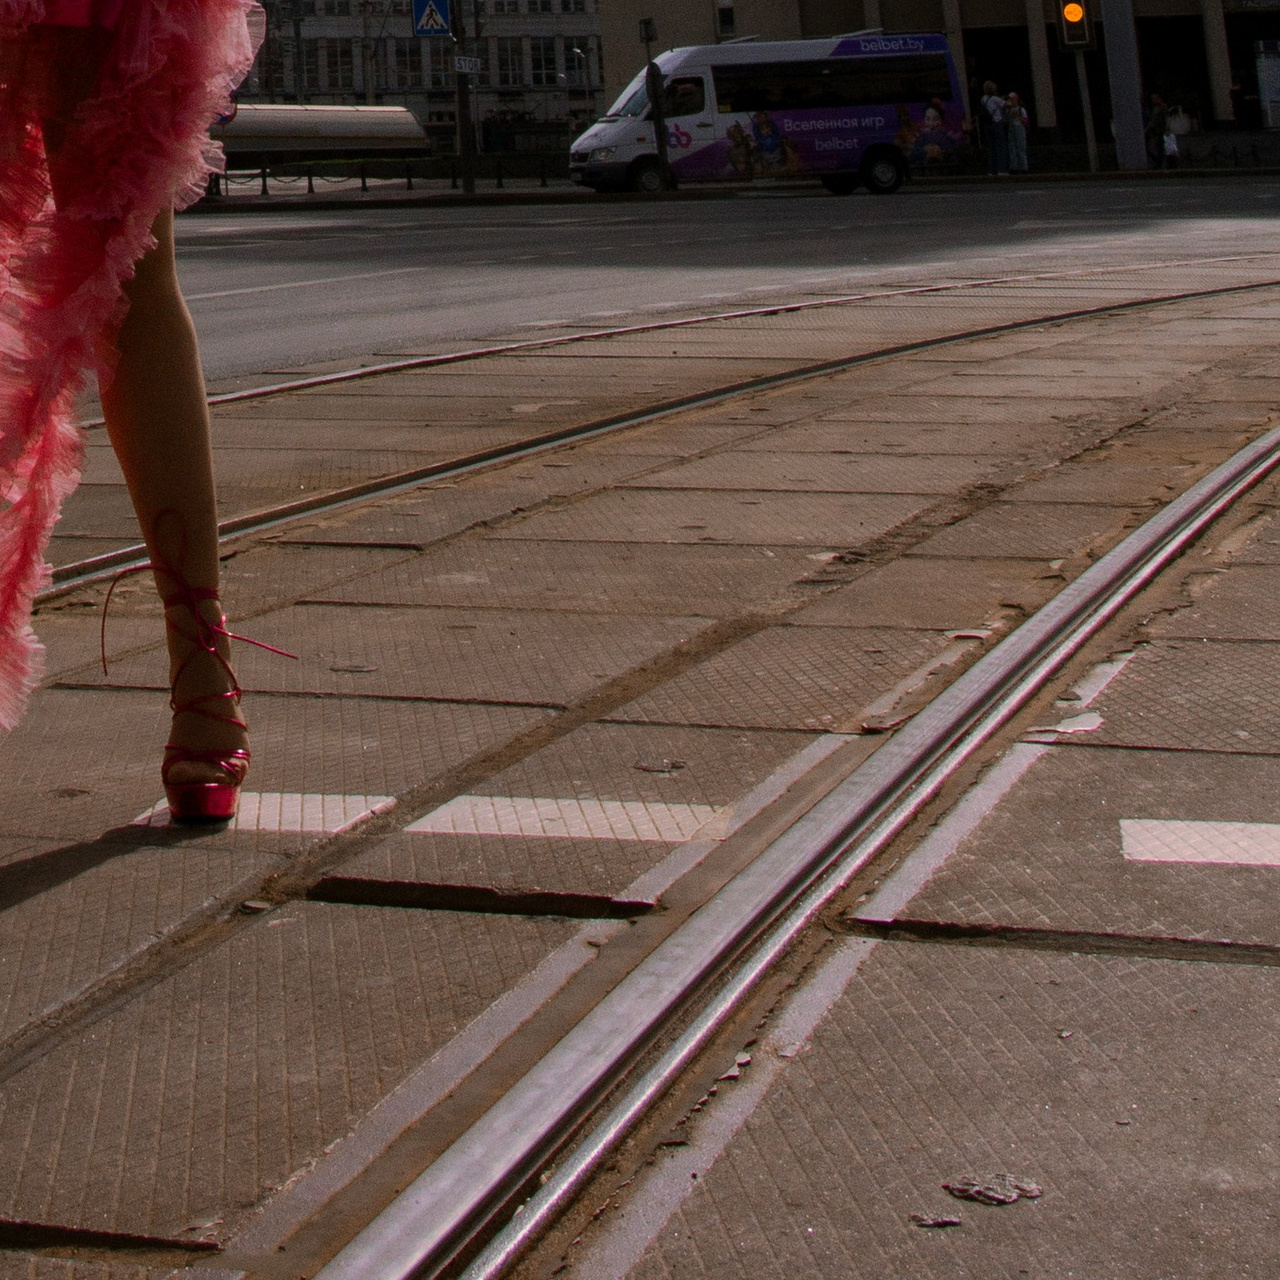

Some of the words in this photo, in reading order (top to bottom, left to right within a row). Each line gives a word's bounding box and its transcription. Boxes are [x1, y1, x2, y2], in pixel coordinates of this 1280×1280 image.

[859, 37, 924, 51] belbet.by
[783, 118, 858, 132] Вселенная
[861, 116, 885, 130] игр
[814, 136, 859, 151] belbet
